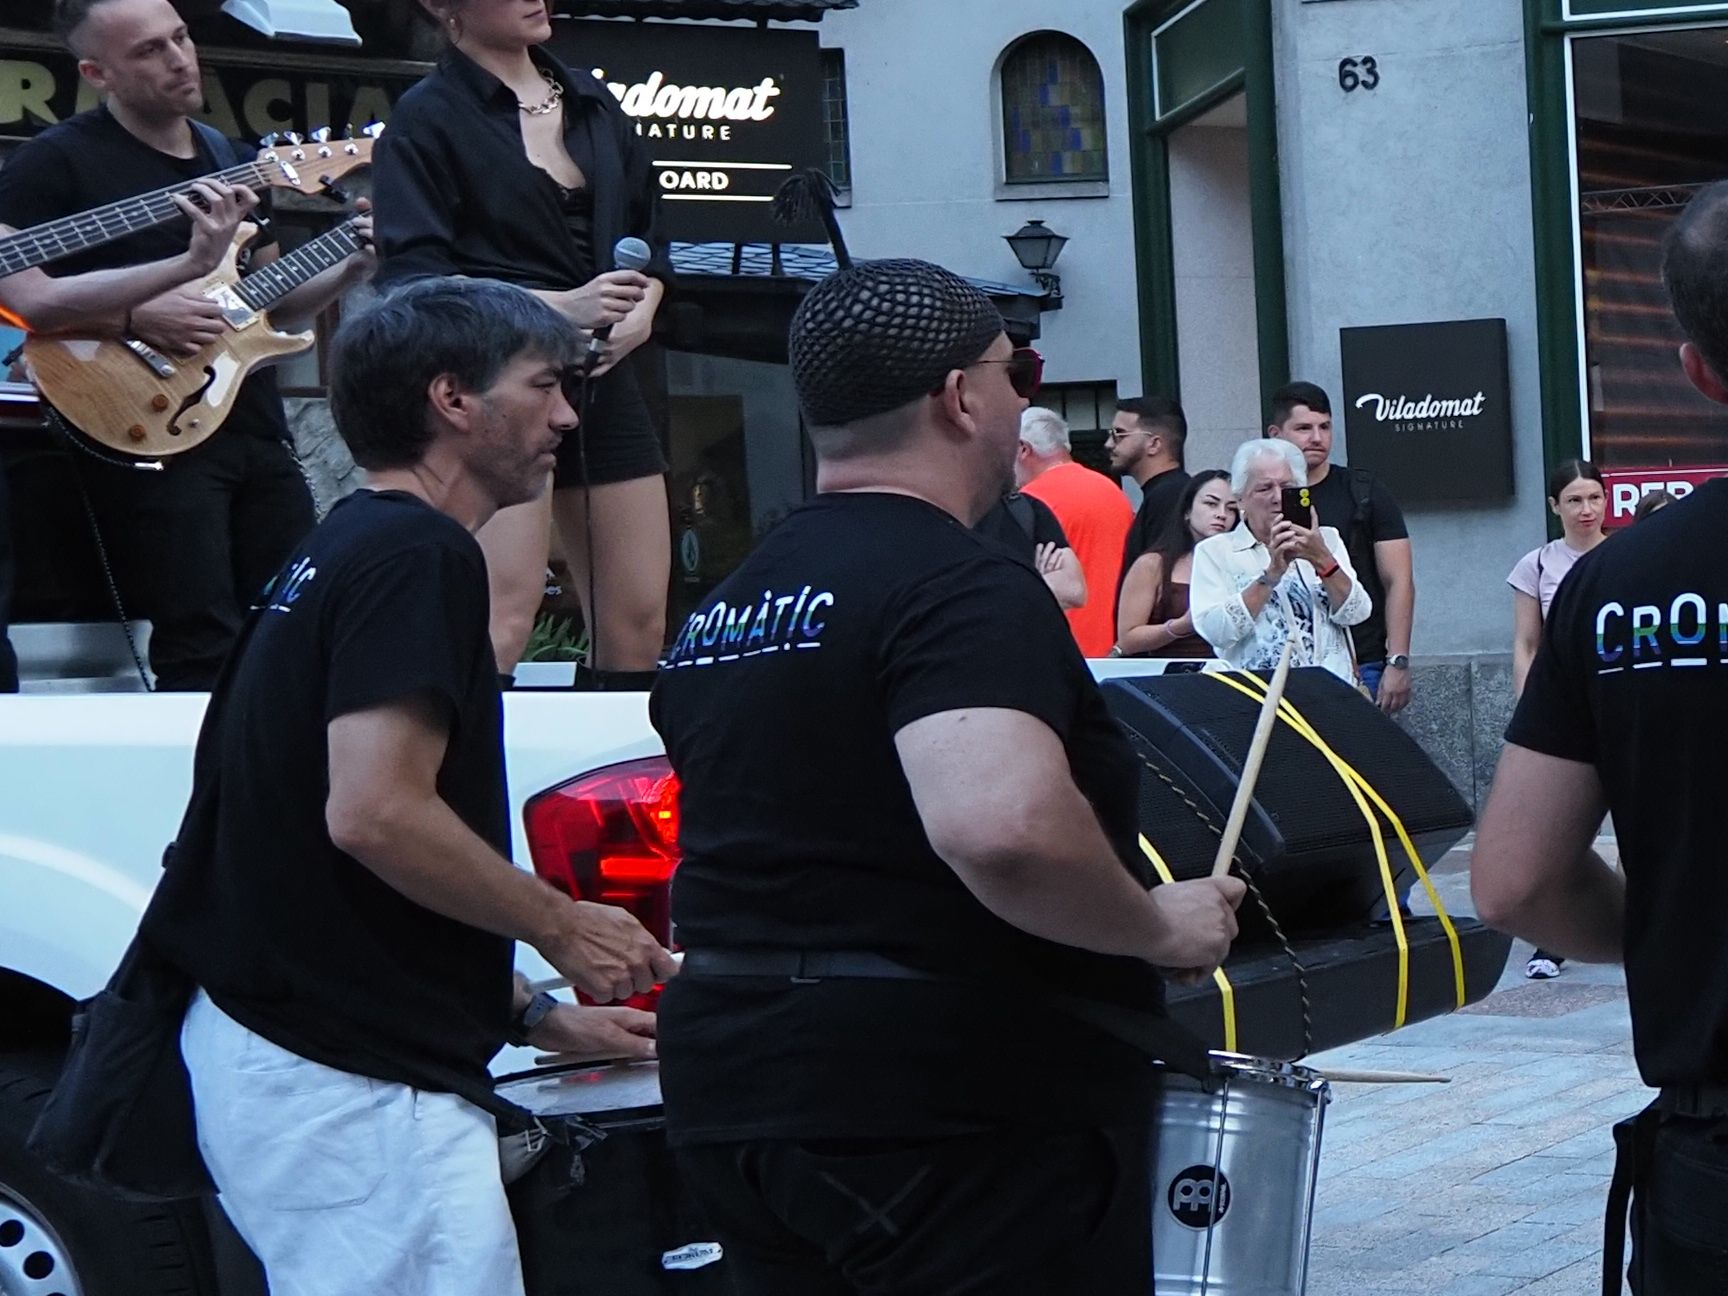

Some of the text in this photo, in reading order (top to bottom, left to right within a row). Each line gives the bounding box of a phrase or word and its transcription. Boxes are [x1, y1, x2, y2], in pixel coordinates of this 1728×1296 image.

[1338, 55, 1380, 93] 63
[634, 123, 732, 141] ATURE
[1355, 390, 1487, 422] Viladomat
[1394, 419, 1464, 432] SIGNATURE
